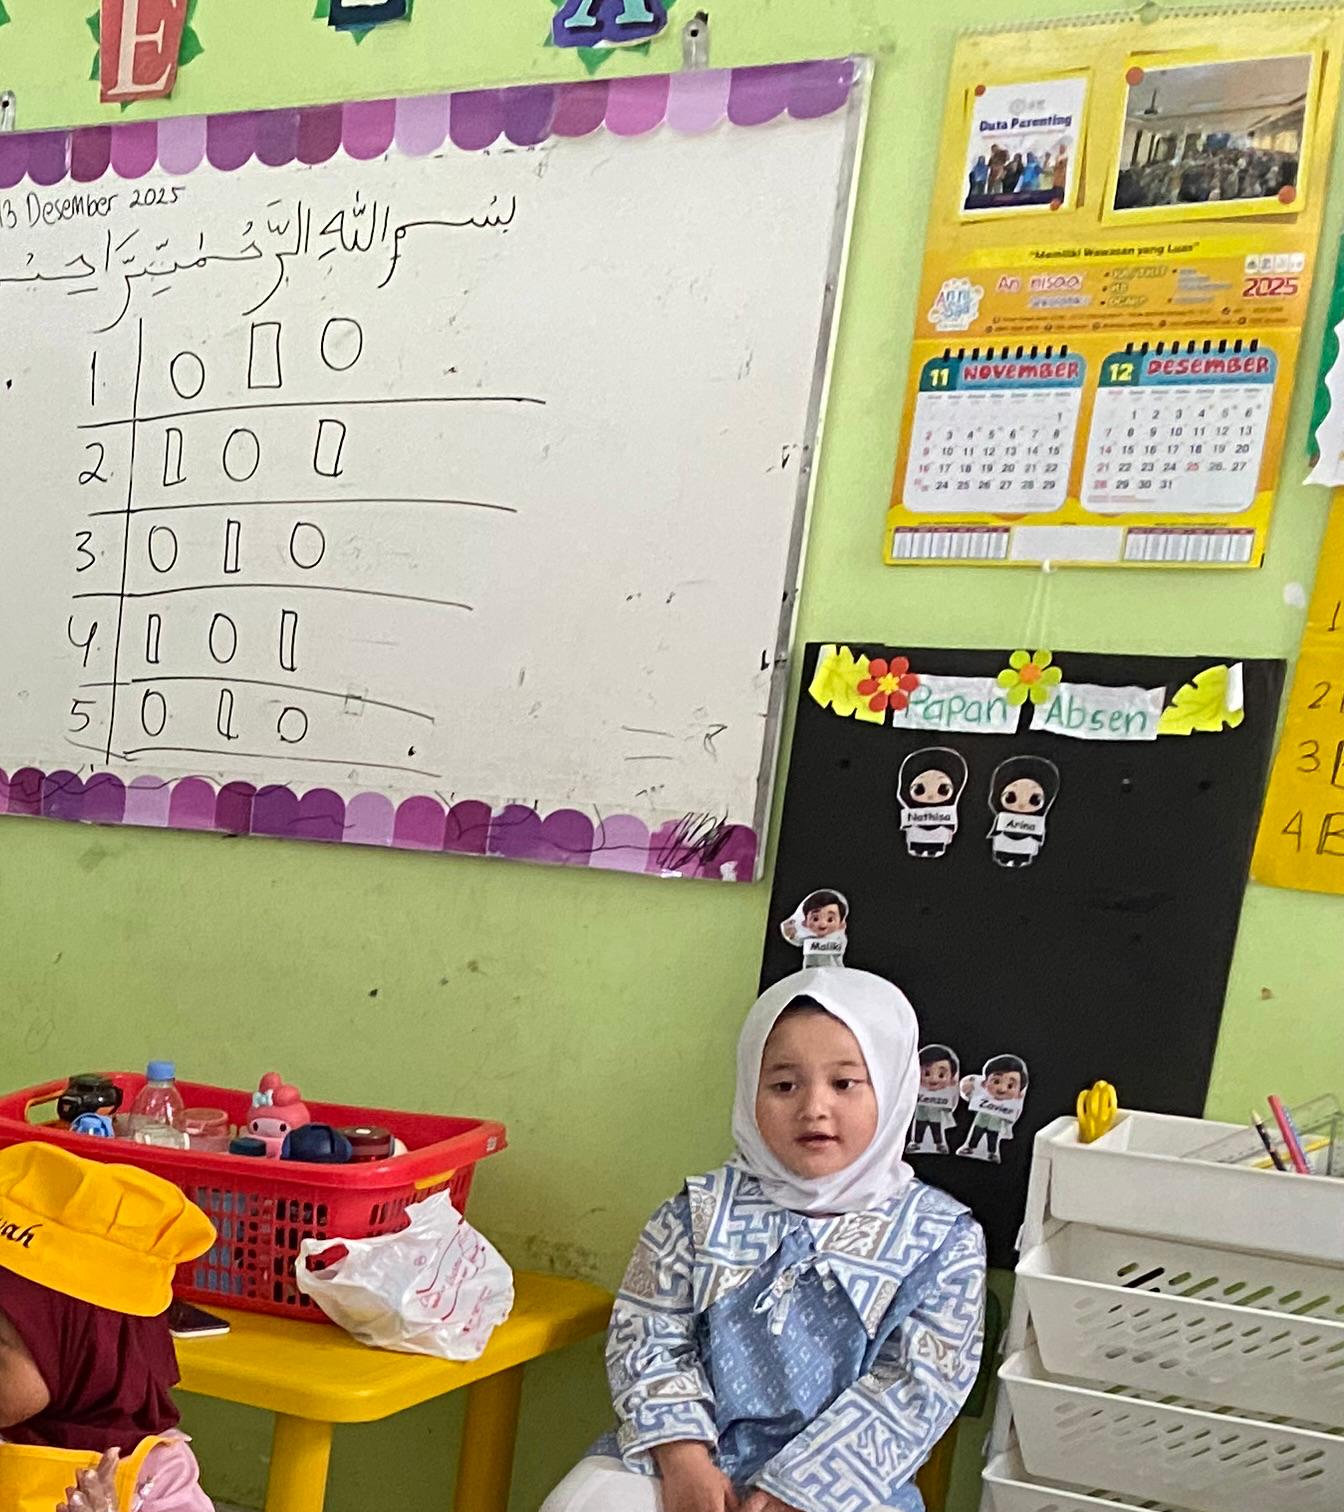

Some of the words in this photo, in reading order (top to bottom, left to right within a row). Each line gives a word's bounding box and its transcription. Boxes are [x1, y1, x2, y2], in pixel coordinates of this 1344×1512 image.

[25, 191, 120, 228] Desember
[129, 186, 187, 208] 2025
[1242, 276, 1300, 298] 2025
[930, 368, 949, 386] 11
[1109, 363, 1134, 381] 12
[1147, 357, 1269, 376] DESEMBER
[905, 683, 1008, 724] Papan
[1045, 696, 1148, 733] Absen
[1308, 680, 1331, 709] 2
[1296, 740, 1321, 772] 3
[1282, 810, 1302, 852] 4
